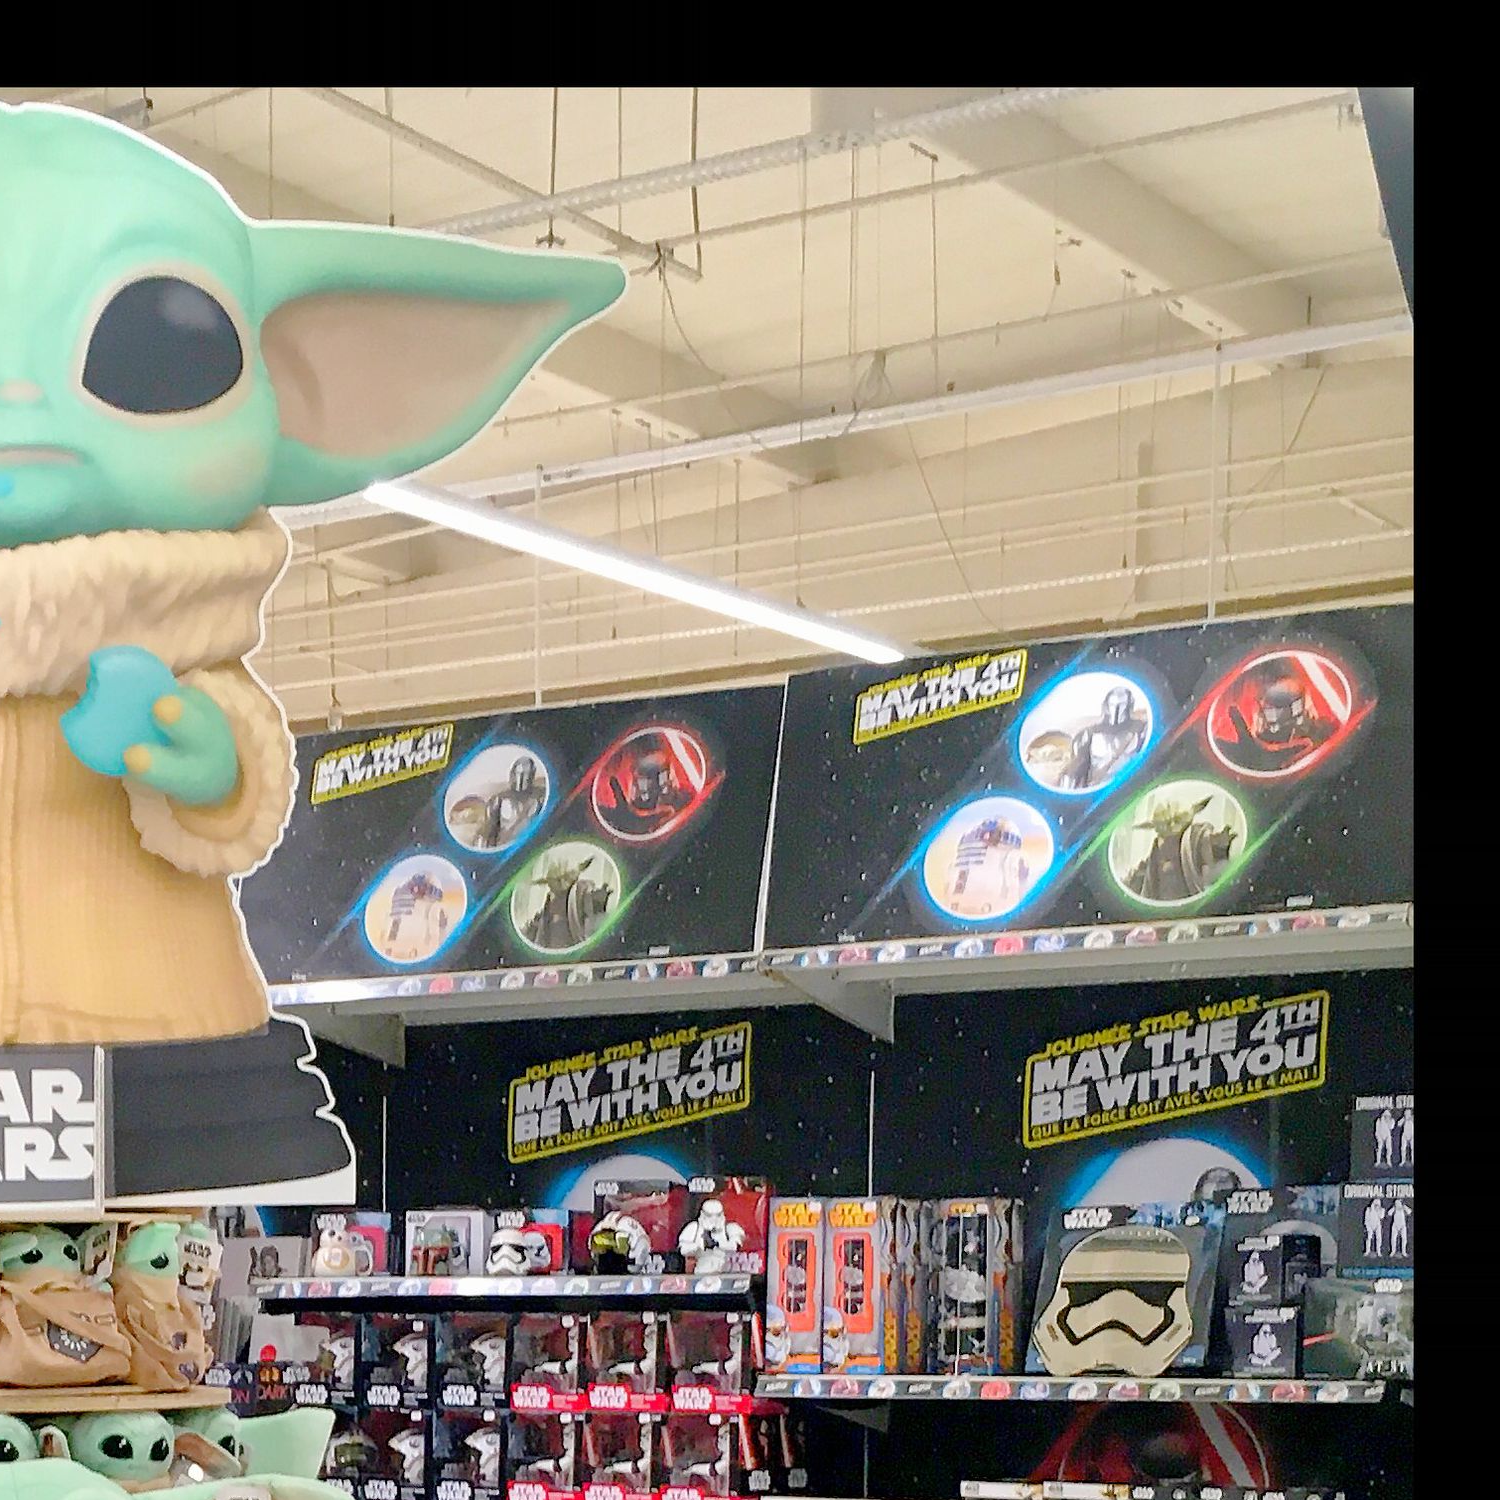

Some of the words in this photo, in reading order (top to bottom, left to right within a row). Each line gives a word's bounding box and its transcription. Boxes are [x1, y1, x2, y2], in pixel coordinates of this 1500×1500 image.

[861, 681, 918, 713] MAY
[925, 666, 977, 697] THE
[981, 652, 1021, 681] 4TH
[891, 687, 961, 721] WITH
[962, 670, 1020, 703] YOU
[318, 751, 366, 776] MAY
[371, 737, 414, 763] THE
[417, 727, 449, 751] 4TH
[344, 757, 401, 785] WITH
[402, 743, 447, 770] YOU
[1134, 1010, 1194, 1038] STAR
[1198, 995, 1261, 1023] WARS
[598, 1039, 648, 1066] STAR
[649, 1025, 699, 1051] WARS
[1032, 1040, 1133, 1094] MAY
[1143, 1016, 1239, 1069] THE
[1250, 998, 1320, 1047] 4TH
[514, 1067, 598, 1114] MAY
[607, 1046, 682, 1092] THE
[690, 1028, 745, 1073] 4TH
[1031, 1085, 1088, 1127] BE
[1093, 1056, 1212, 1111] WITH
[1221, 1033, 1318, 1084] YOU
[514, 1105, 562, 1145] BE
[567, 1081, 660, 1130] WITH
[665, 1060, 743, 1105] YOU
[1031, 1122, 1059, 1140] QUE
[1063, 1118, 1082, 1134] LA
[1083, 1108, 1126, 1130] FORCE
[1129, 1100, 1161, 1120] SOIT
[1164, 1093, 1202, 1113] AVEC
[1203, 1082, 1244, 1103] VOUS
[1246, 1077, 1263, 1092] LE
[1278, 1067, 1311, 1087] MAI
[594, 1120, 620, 1138] SOIT
[622, 1112, 652, 1132] AVEC
[653, 1105, 685, 1123] VOUS
[776, 1202, 809, 1217] STA
[832, 1202, 865, 1217] STA
[512, 1396, 550, 1409] WARS
[516, 1386, 550, 1398] STAR
[589, 1396, 628, 1409] WARS
[592, 1386, 627, 1398] STAR
[673, 1397, 713, 1410] WARS
[676, 1387, 713, 1399] STAR
[512, 1483, 547, 1495] STAR
[587, 1485, 623, 1497] STAR
[665, 1488, 701, 1500] STAR
